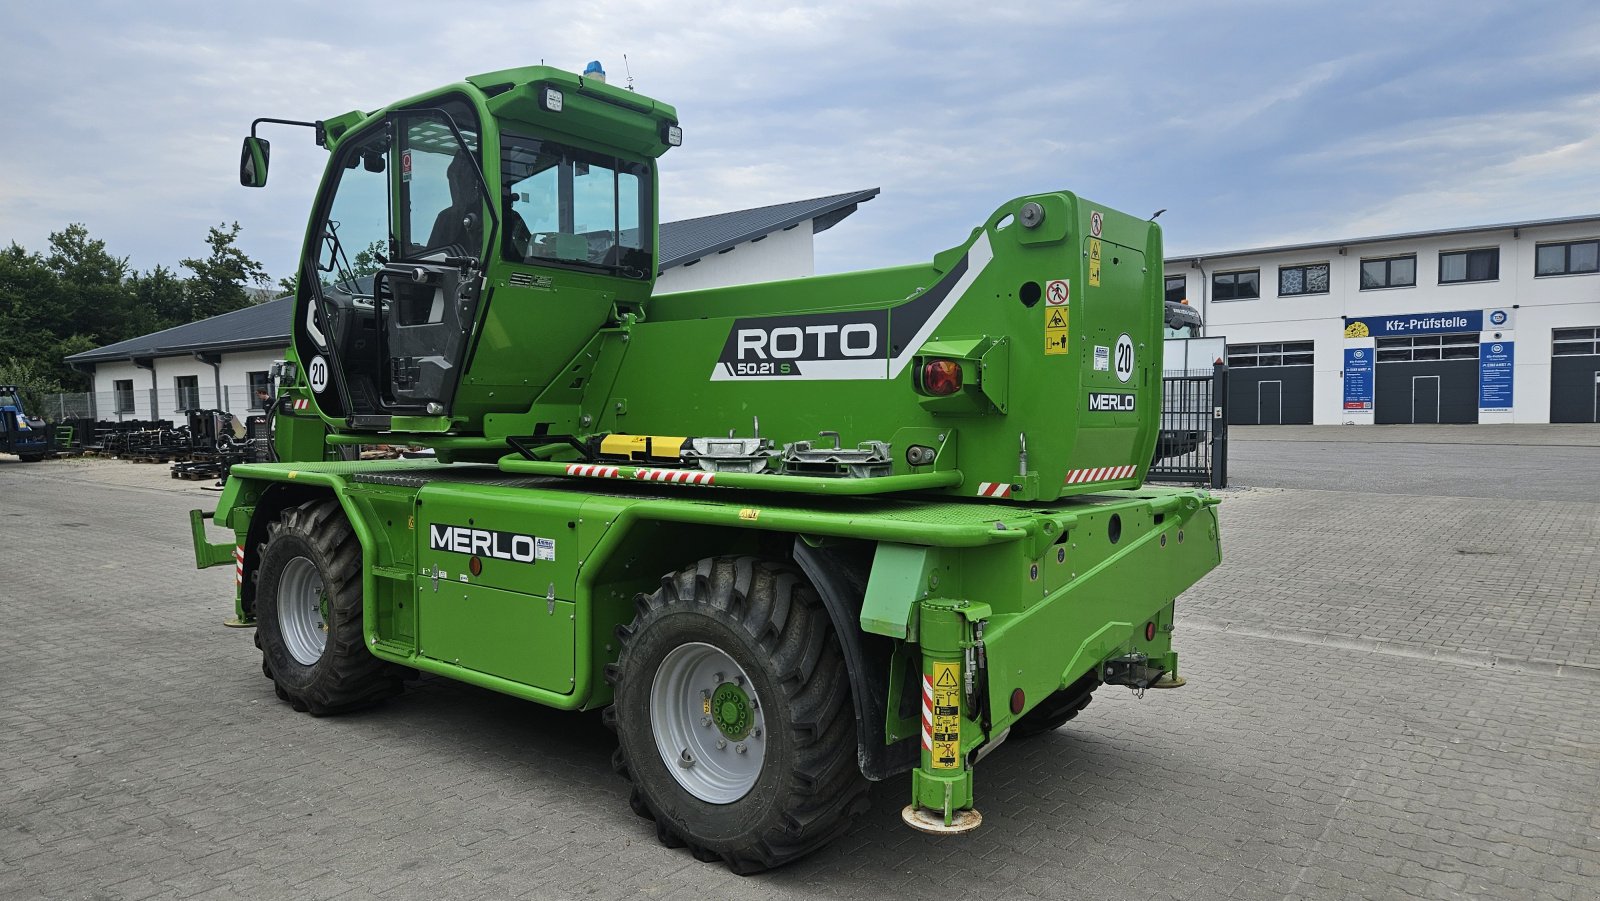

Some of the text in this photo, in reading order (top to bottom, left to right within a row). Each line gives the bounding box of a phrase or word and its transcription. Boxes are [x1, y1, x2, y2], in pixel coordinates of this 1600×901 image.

[1386, 316, 1467, 331] Kfz-Prüfstelle
[737, 323, 878, 359] ROTO
[737, 362, 791, 375] 50.21 S
[1117, 342, 1131, 373] 20
[312, 362, 325, 386] 20
[1089, 394, 1134, 411] MERLO
[430, 524, 535, 563] MERLO
